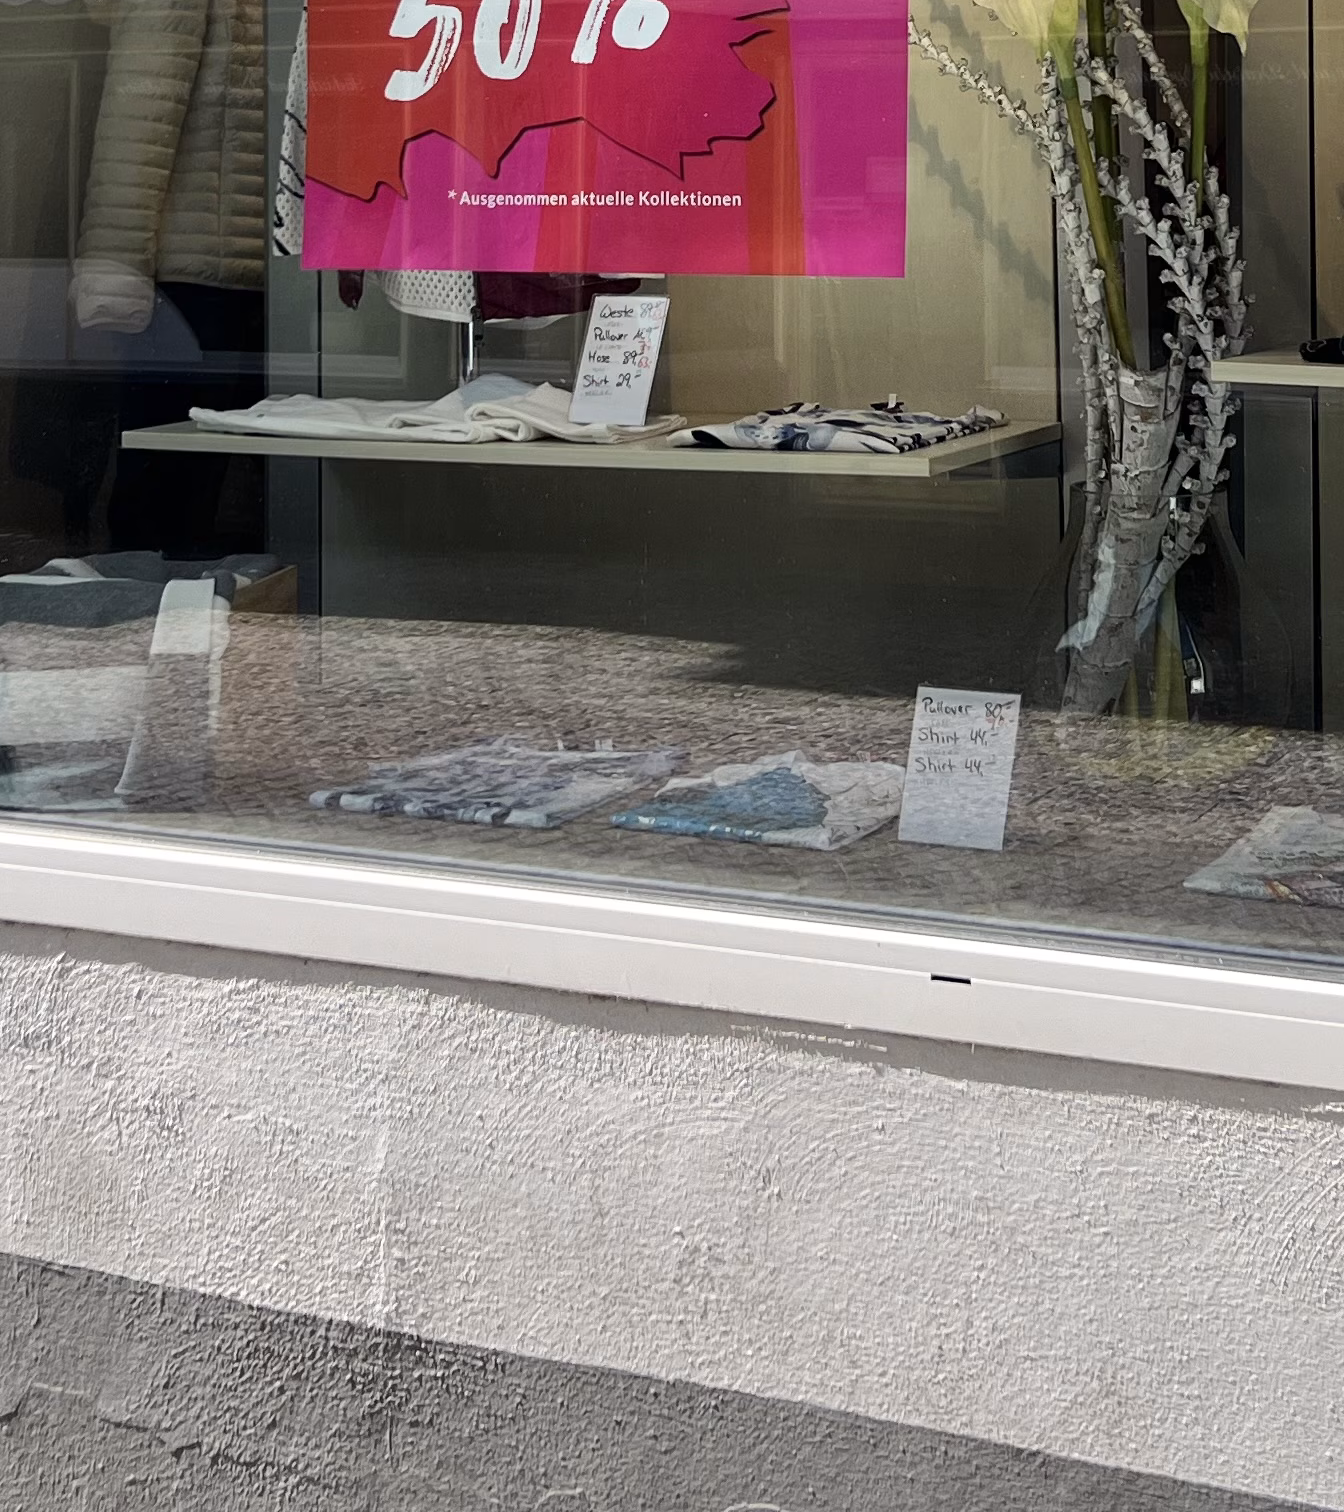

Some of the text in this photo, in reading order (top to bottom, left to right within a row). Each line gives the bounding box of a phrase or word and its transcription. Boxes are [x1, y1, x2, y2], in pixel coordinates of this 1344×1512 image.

[571, 190, 635, 207] aktuelle
[637, 190, 743, 208] Kollektionen
[599, 303, 634, 318] Weste
[922, 696, 975, 716] Pullover
[918, 728, 960, 745] Shirt
[914, 757, 956, 774] Shirt
